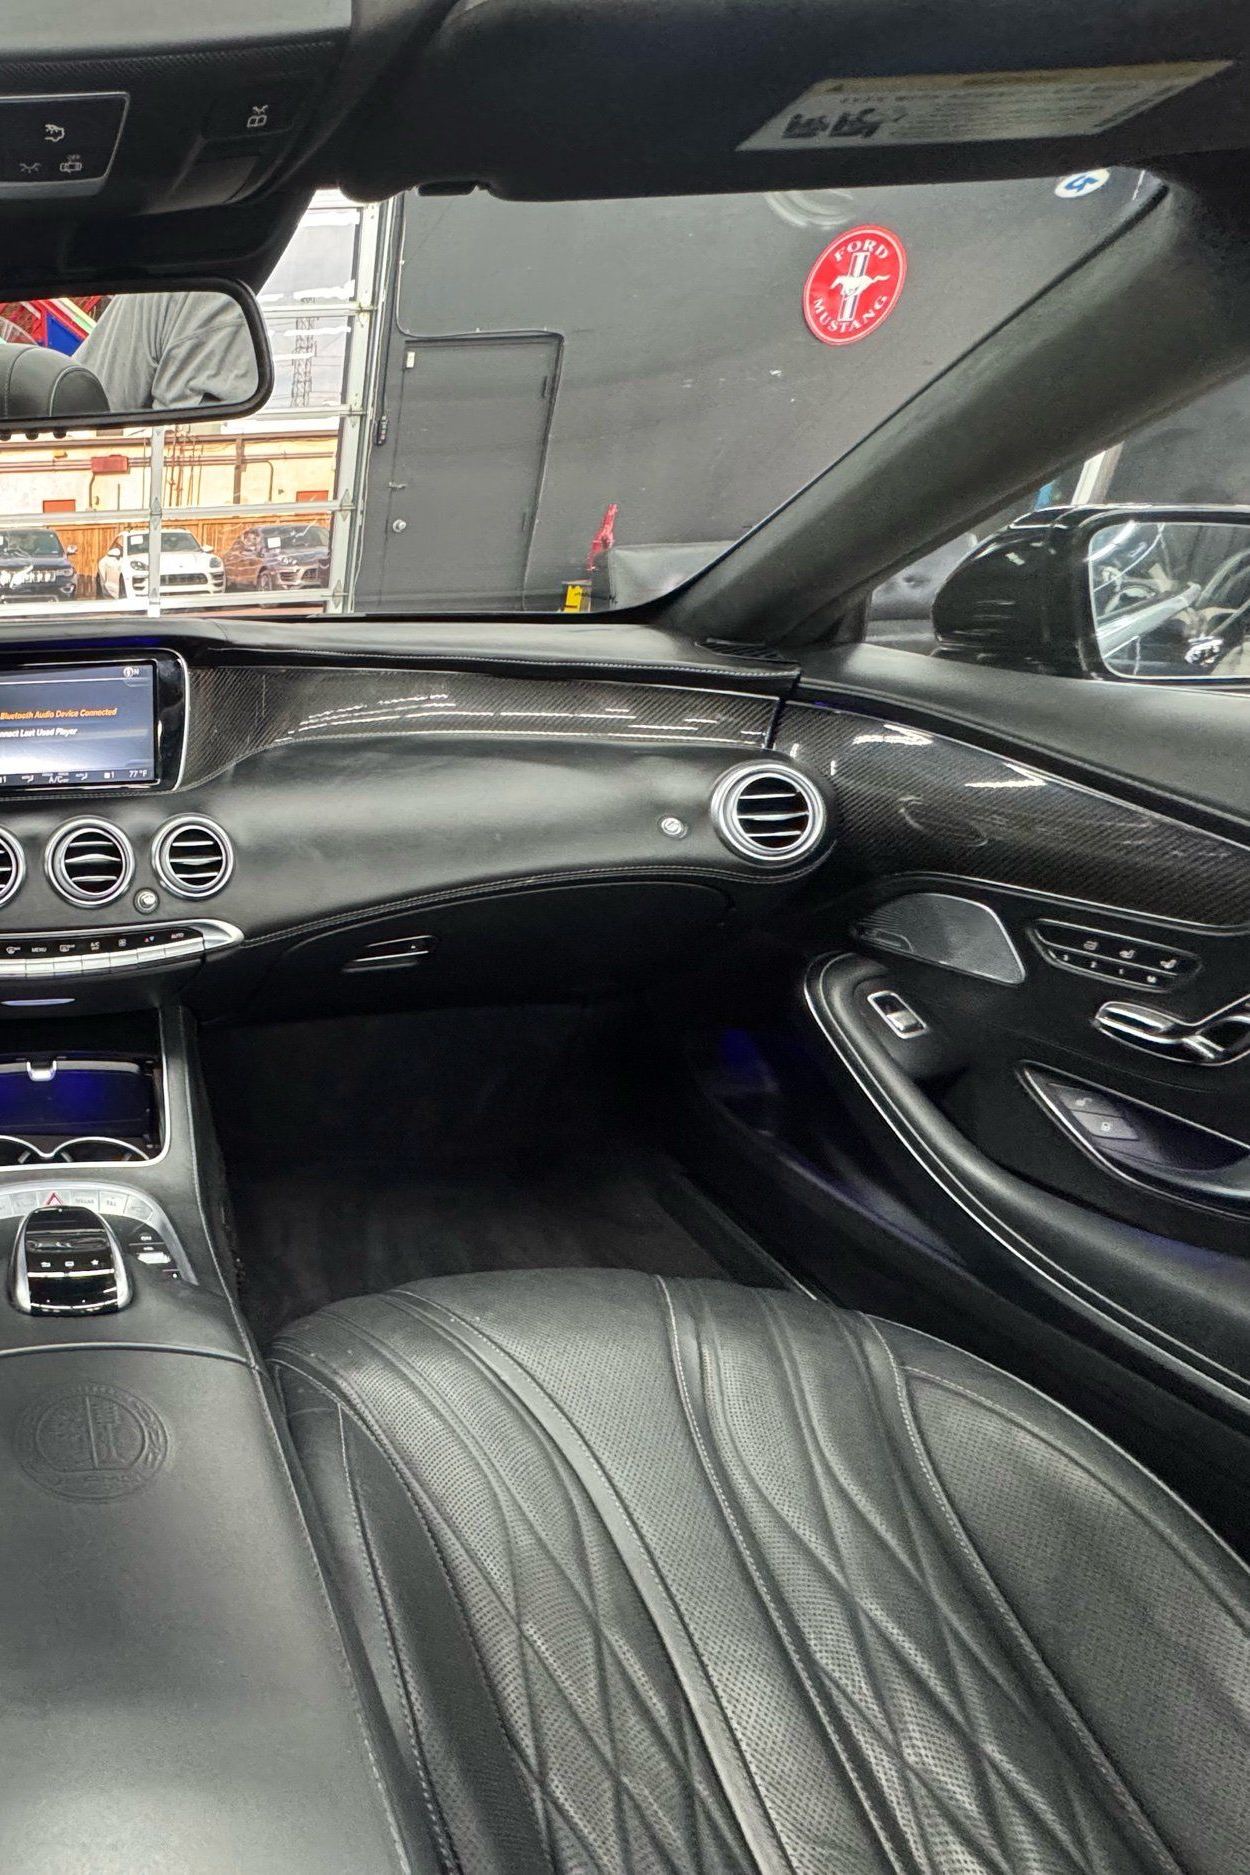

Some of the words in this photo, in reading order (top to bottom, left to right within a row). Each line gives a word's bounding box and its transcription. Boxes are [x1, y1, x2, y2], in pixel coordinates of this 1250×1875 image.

[834, 239, 889, 262] FORD
[813, 295, 888, 333] MUSTANG
[0, 711, 33, 720] Bluetooth
[35, 710, 53, 719] Audio
[55, 709, 79, 718] Device
[80, 708, 117, 716] Connected
[20, 728, 35, 737] Last
[37, 728, 54, 736] Used
[55, 728, 78, 737] Player
